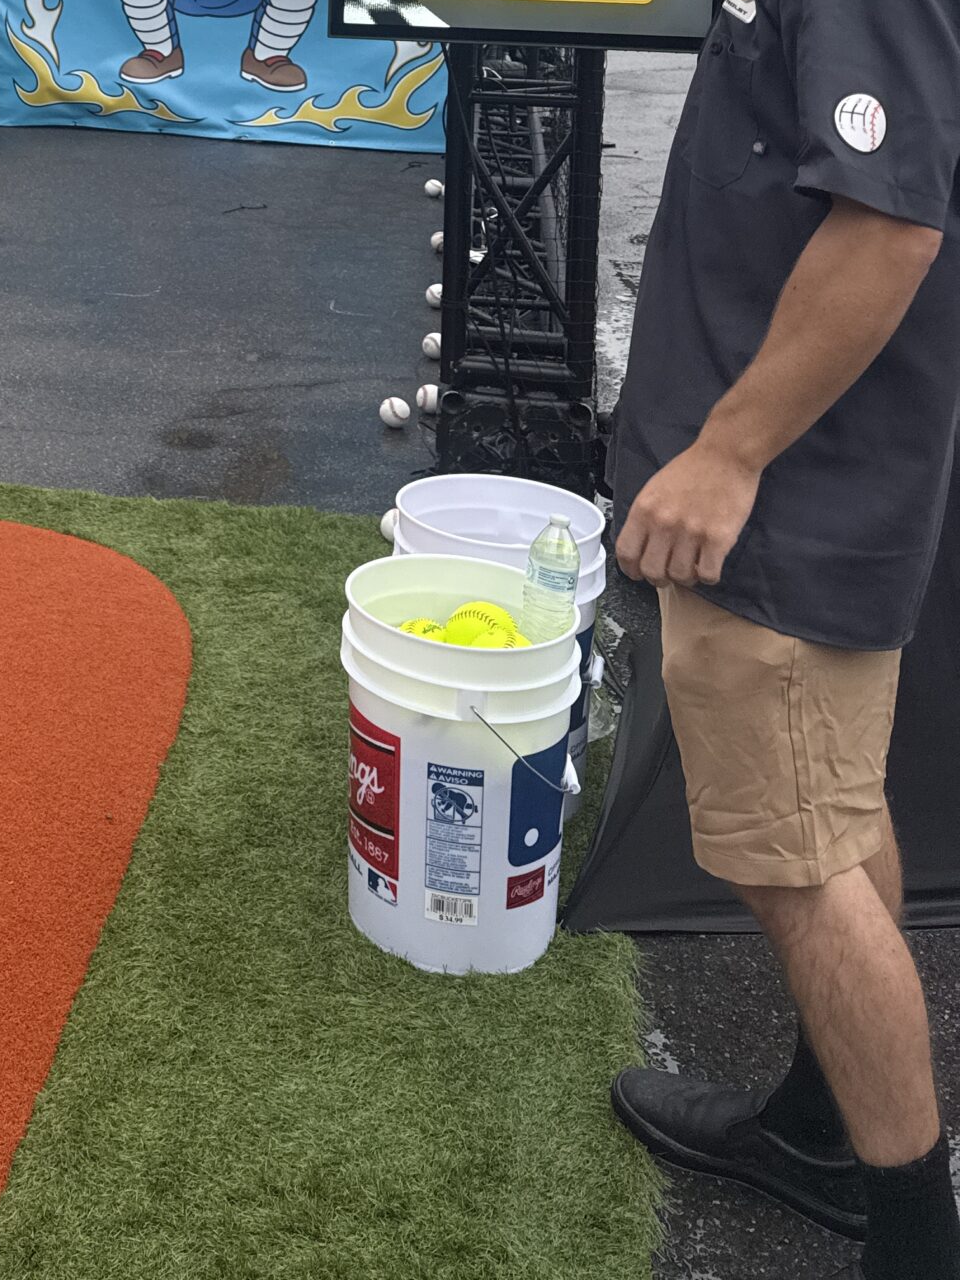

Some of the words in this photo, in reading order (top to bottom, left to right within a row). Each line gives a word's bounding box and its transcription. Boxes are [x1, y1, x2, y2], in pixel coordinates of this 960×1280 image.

[437, 766, 483, 779] WARNING
[438, 774, 469, 785] AVISO
[363, 836, 390, 864] 1887
